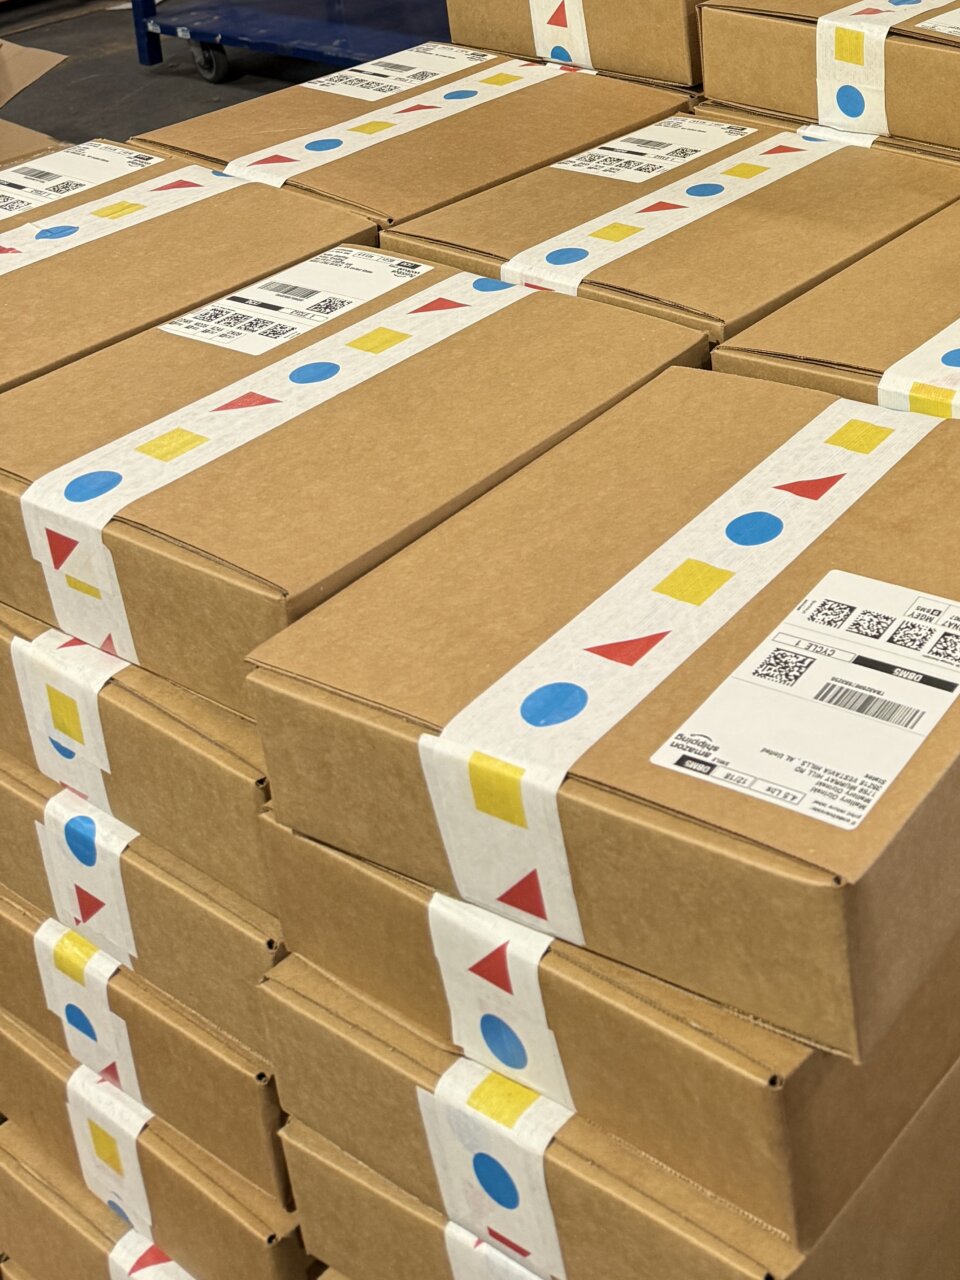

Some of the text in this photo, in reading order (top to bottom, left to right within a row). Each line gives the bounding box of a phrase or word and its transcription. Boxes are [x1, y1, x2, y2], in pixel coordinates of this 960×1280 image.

[906, 610, 936, 623] MGEY
[803, 642, 836, 657] CYCLE
[890, 666, 925, 682] DBM5
[668, 740, 712, 759] amazon
[672, 732, 721, 753] shipping
[759, 746, 785, 759] United
[681, 758, 712, 773] DBM5
[799, 759, 823, 771] HILLS
[722, 772, 748, 785] 12/18
[805, 769, 825, 780] HILL
[821, 767, 859, 783] VESTAVIA
[862, 772, 887, 785] States
[823, 775, 858, 791] MURRAY
[763, 785, 783, 797] Lbs
[842, 789, 873, 804] Mallory
[837, 795, 868, 810] Mallory
